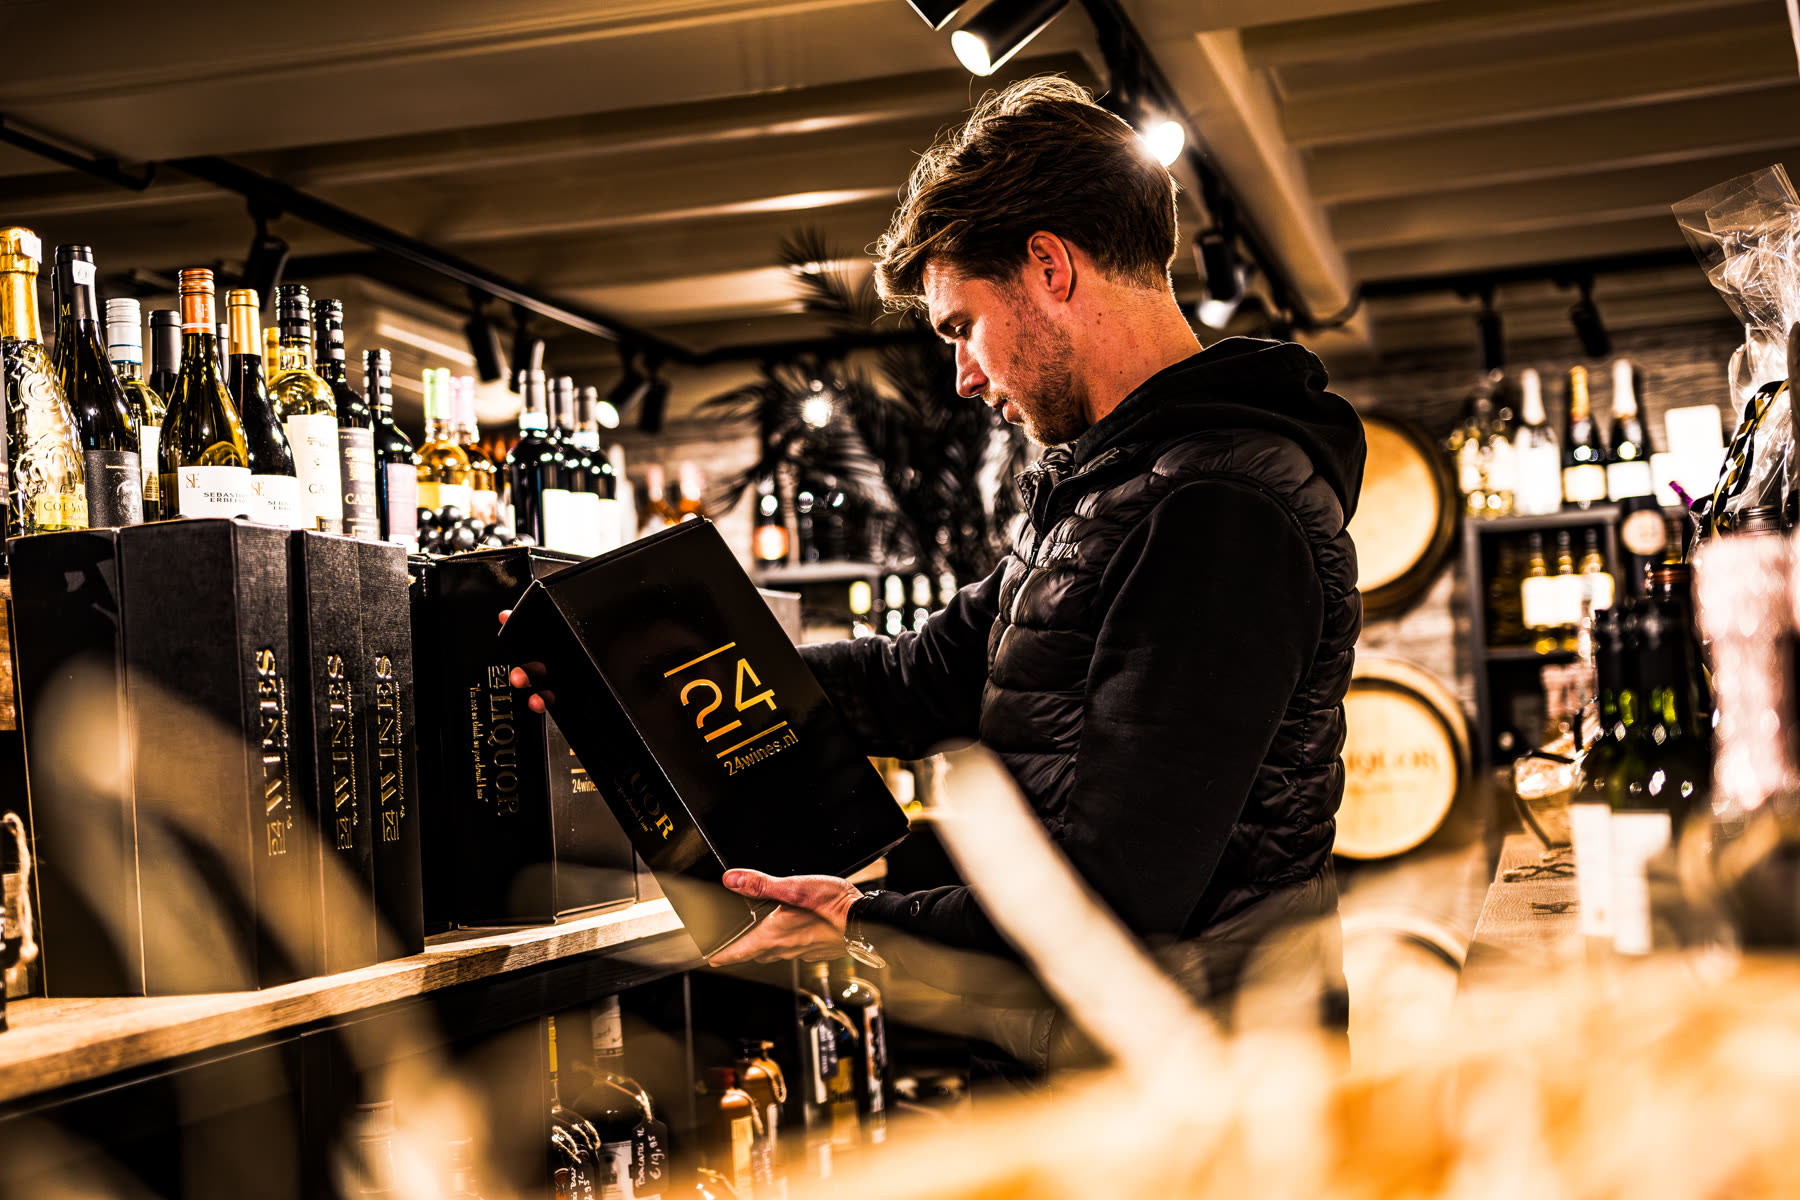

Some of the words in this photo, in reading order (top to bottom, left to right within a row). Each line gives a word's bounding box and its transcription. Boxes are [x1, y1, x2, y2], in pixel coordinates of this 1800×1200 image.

[61, 303, 71, 317] M
[491, 664, 508, 690] 24
[680, 658, 778, 743] 24
[256, 648, 283, 816] WINES
[326, 653, 350, 812] WINES
[375, 655, 397, 806] WINES
[471, 720, 484, 740] think
[471, 749, 482, 763] you
[487, 692, 520, 818] LIQUOR
[723, 728, 799, 776] 24wines.nl
[269, 820, 285, 855] 24
[337, 816, 352, 850] 24
[383, 809, 398, 842] 24
